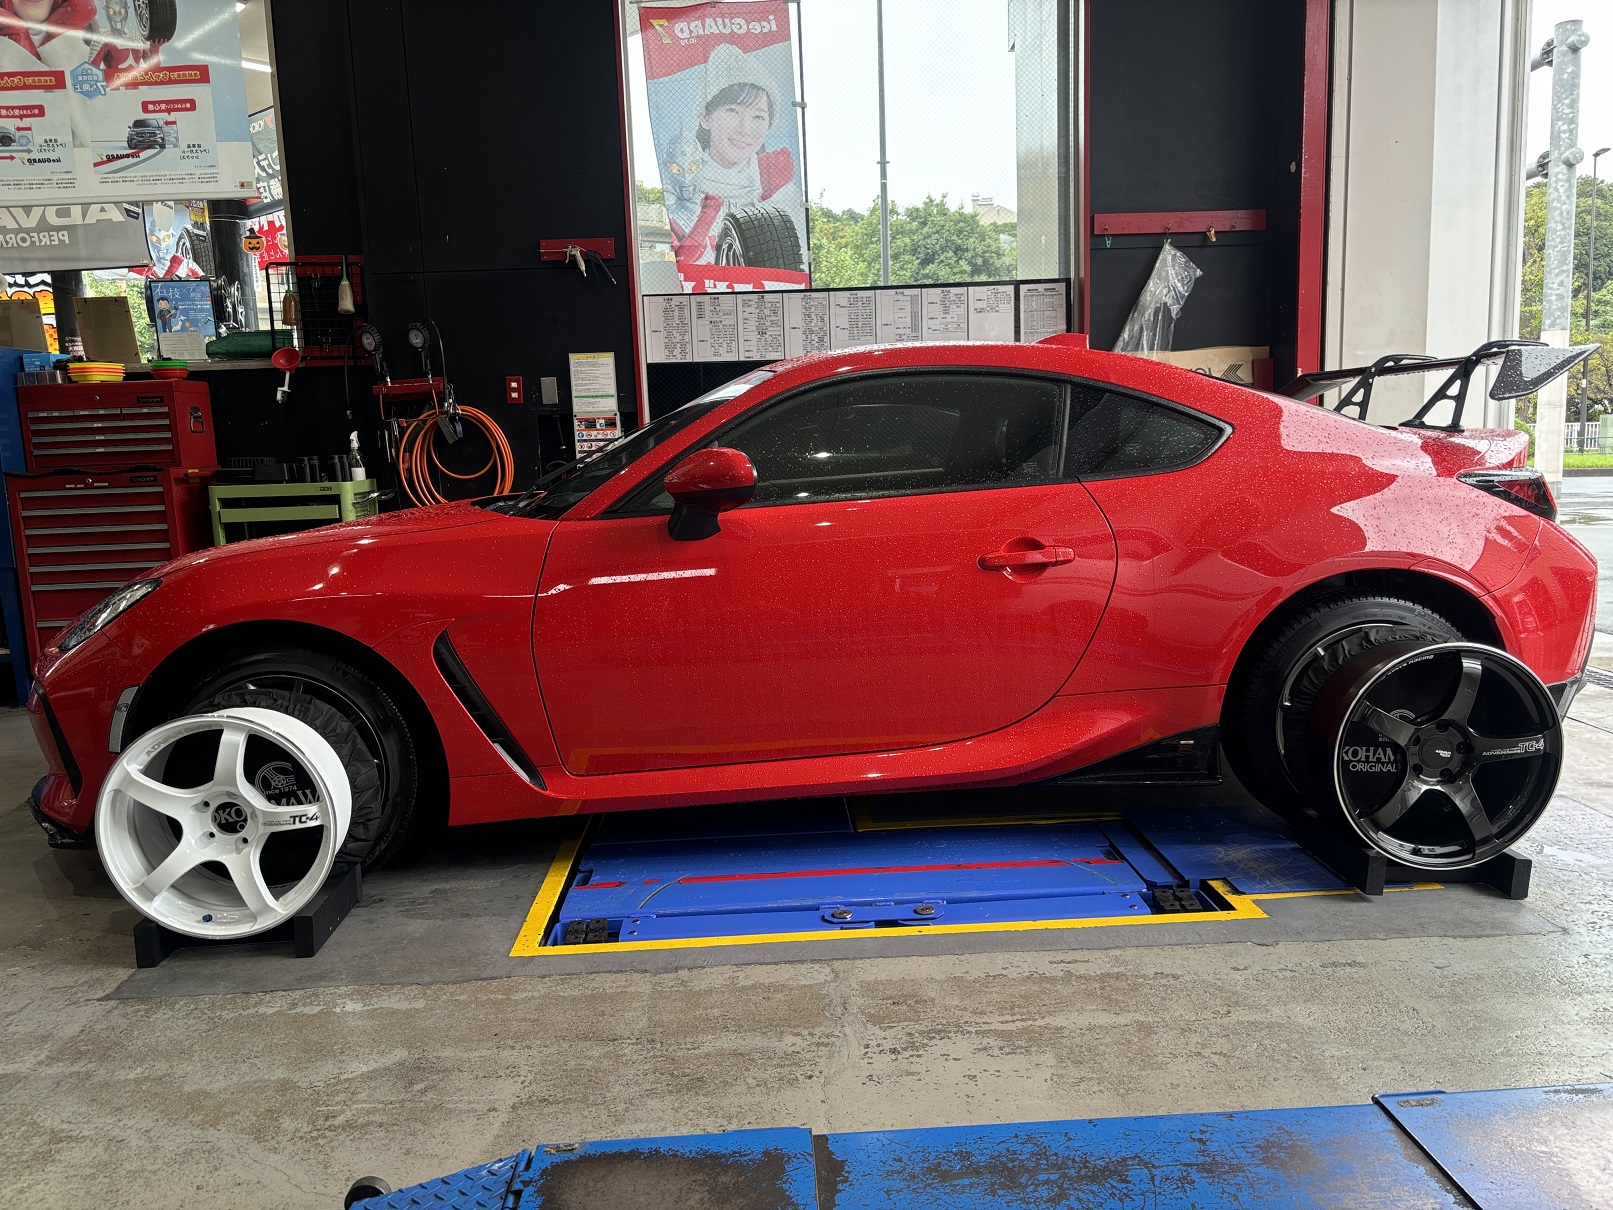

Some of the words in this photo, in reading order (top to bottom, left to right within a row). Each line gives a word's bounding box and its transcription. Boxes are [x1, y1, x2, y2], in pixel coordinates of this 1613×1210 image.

[1349, 762, 1397, 772] ORIGINAL
[280, 785, 298, 793] 1974
[290, 811, 320, 825] TC-4
